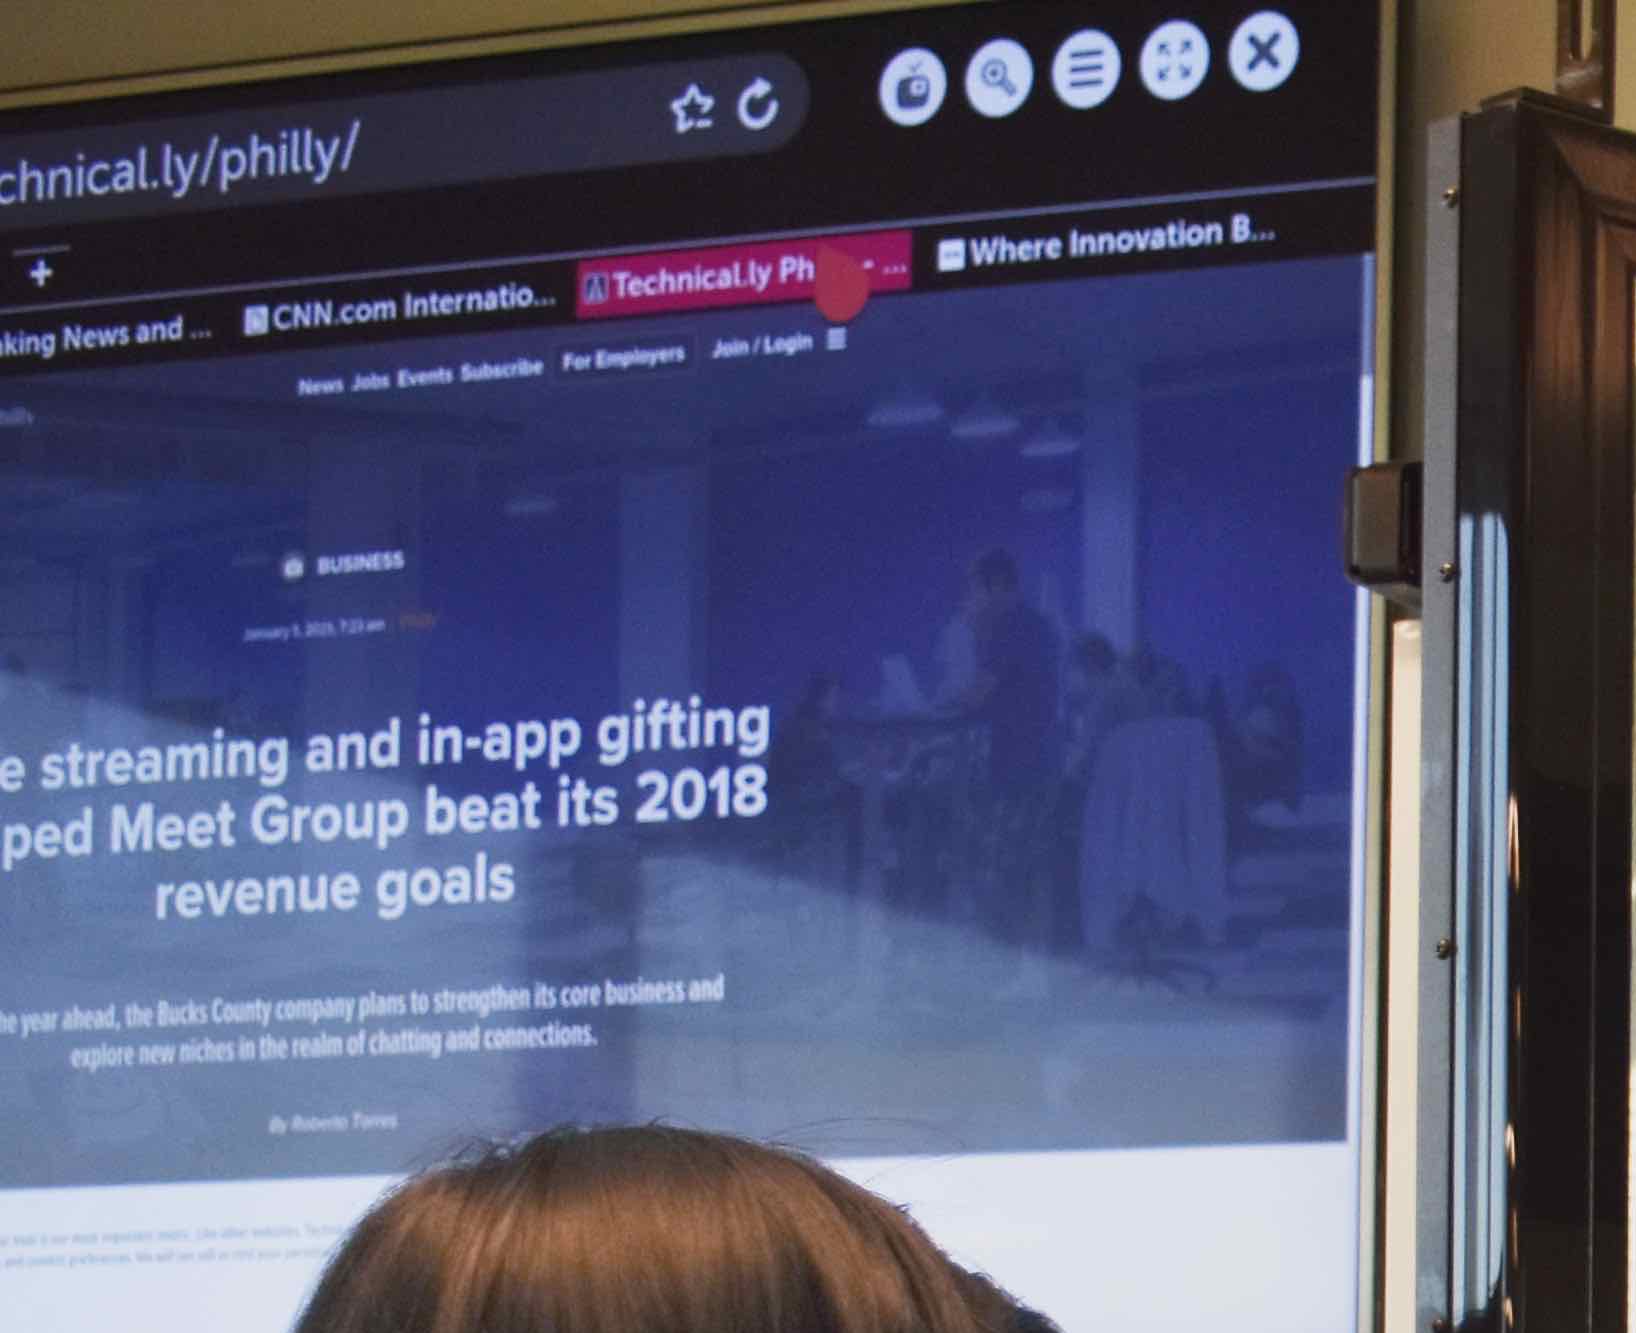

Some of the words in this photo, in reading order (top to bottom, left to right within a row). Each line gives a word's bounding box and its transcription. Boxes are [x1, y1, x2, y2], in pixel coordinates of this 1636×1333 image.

[970, 234, 1062, 267] Where
[1069, 219, 1223, 258] Innovation
[612, 259, 772, 298] Technical.ly
[62, 325, 130, 351] News
[135, 314, 183, 344] and
[273, 299, 396, 331] CNN.com
[562, 353, 591, 372] For
[595, 345, 686, 371] Employers
[712, 336, 750, 359] Join
[763, 332, 813, 357] Login
[297, 378, 344, 398] News
[351, 373, 391, 392] Jobs
[397, 366, 454, 389] Events
[460, 357, 544, 383] Subscribe
[317, 549, 405, 575] BUSINESS
[40, 727, 289, 790] streaming
[305, 716, 400, 772] and
[418, 712, 582, 771] in-app
[597, 695, 770, 766] gifting
[2, 806, 94, 872] ped
[110, 801, 236, 853] Meet
[251, 794, 409, 849] Group
[426, 781, 542, 835] beat
[558, 773, 619, 827] its
[635, 763, 769, 824] 2018
[155, 870, 360, 920] revenue
[376, 851, 515, 920] goals
[21, 1010, 57, 1039] year
[62, 1004, 121, 1031] ahead,
[125, 1002, 153, 1029] the
[157, 999, 208, 1027] Bucks
[211, 997, 272, 1027] County
[275, 994, 356, 1025] company
[358, 990, 406, 1022] plans
[410, 989, 430, 1015] to
[433, 985, 532, 1019] strengthen
[535, 982, 557, 1010] its
[560, 984, 602, 1008] core
[604, 976, 687, 1006] business
[688, 973, 725, 1002] and
[70, 1044, 133, 1073] explore
[139, 1046, 175, 1066] new
[178, 1037, 235, 1065] niches
[239, 1036, 256, 1061] in
[259, 1034, 289, 1061] the
[291, 1031, 343, 1059] realm
[346, 1028, 366, 1057] of
[369, 1026, 442, 1059] chatting
[445, 1025, 481, 1052] and
[483, 1020, 598, 1050] connections.
